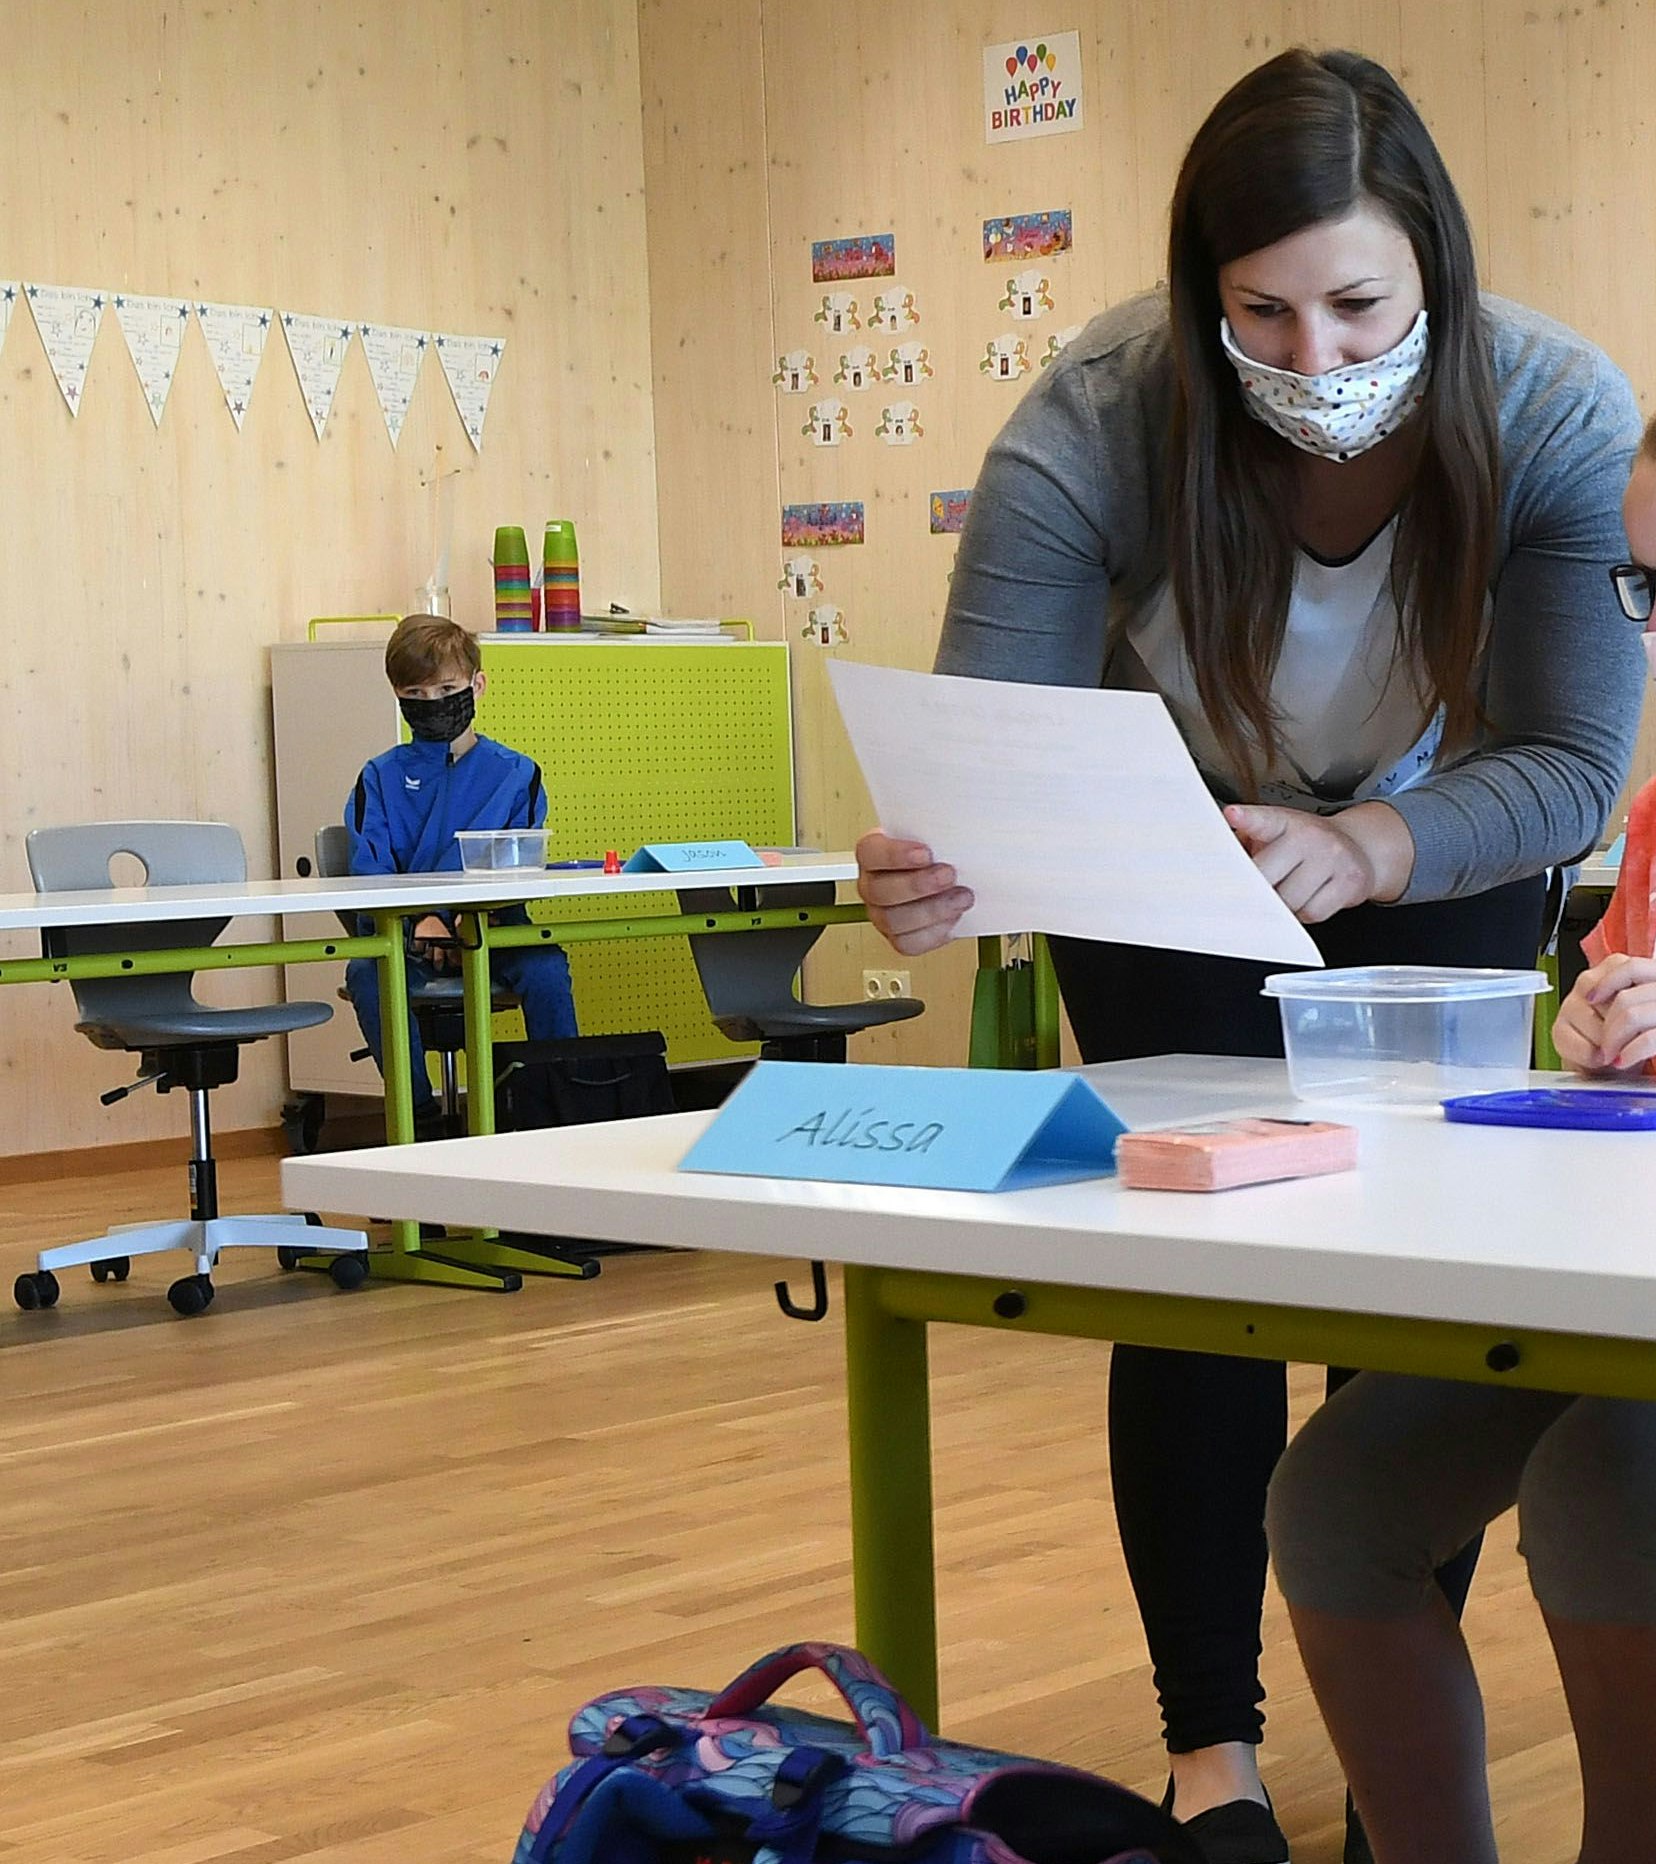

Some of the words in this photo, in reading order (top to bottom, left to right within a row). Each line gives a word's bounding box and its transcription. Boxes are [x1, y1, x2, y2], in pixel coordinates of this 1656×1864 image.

[1004, 76, 1061, 106] HAPPY
[991, 98, 1077, 130] BIRTHDAY
[775, 1107, 944, 1154] Alissa
